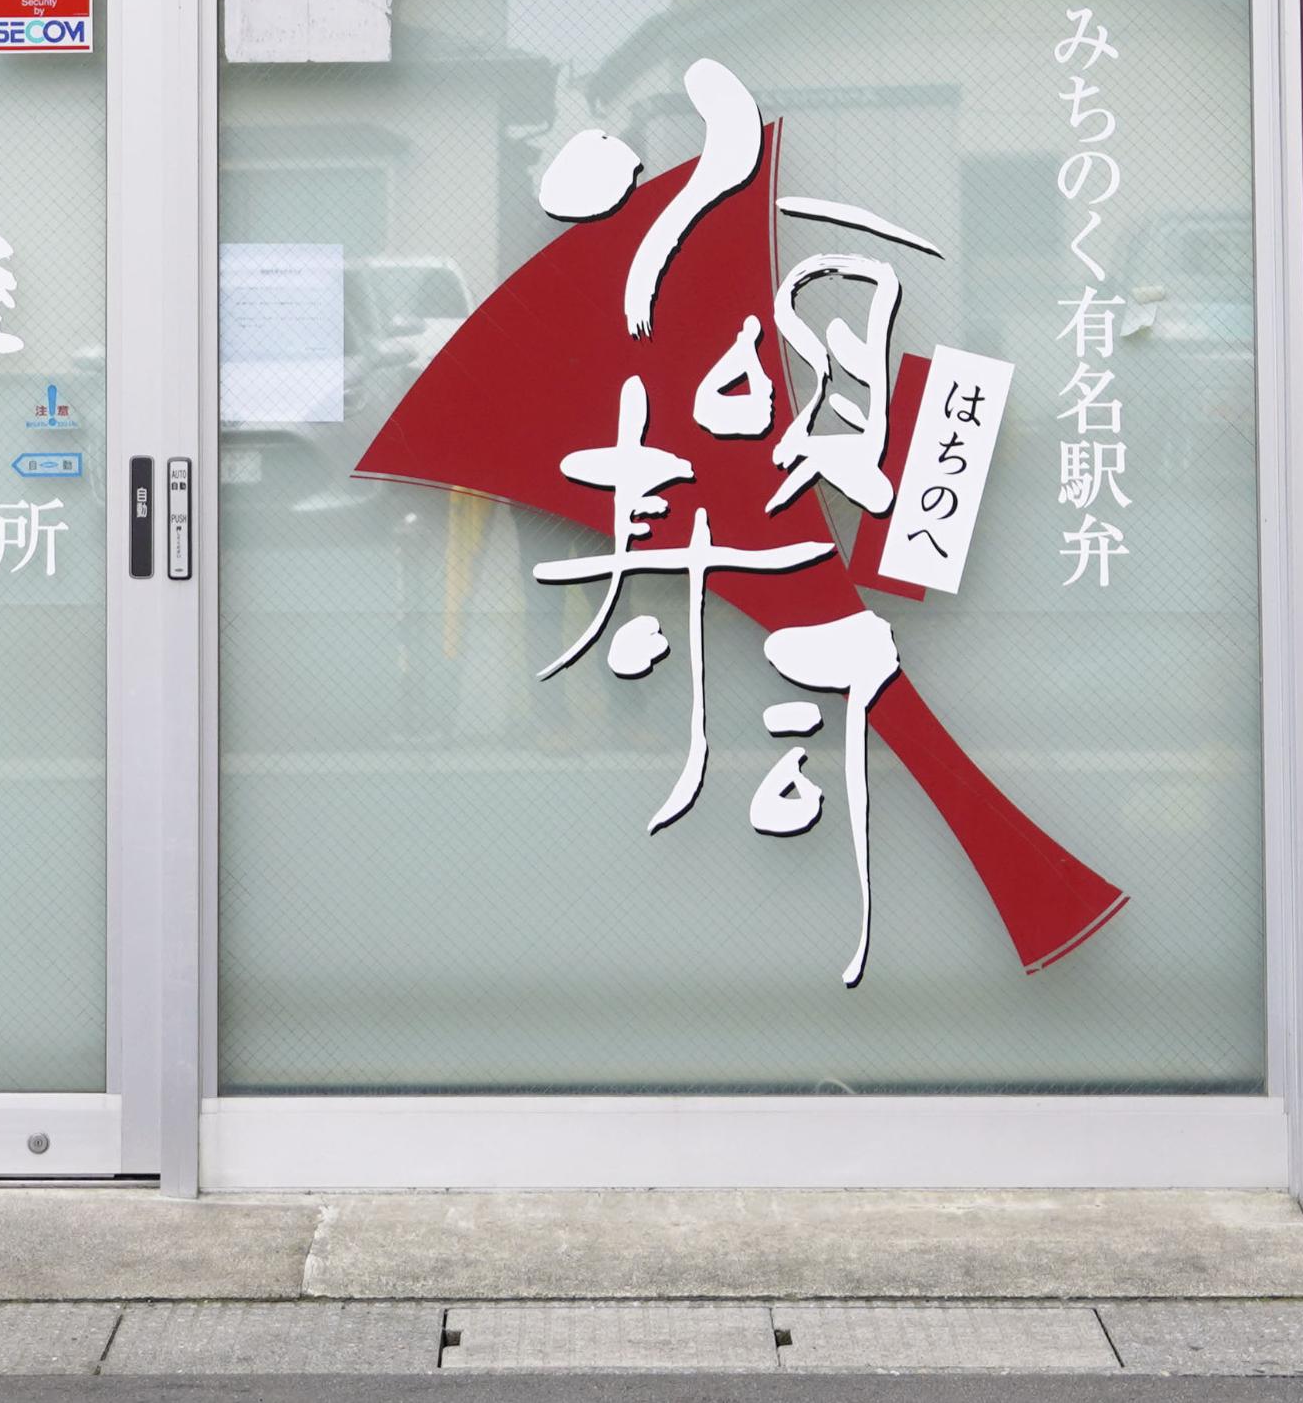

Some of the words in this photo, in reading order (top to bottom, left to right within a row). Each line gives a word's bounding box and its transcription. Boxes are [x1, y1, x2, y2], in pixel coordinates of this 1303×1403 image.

[33, 7, 45, 17] by
[1054, 6, 1133, 588] みちのく有名駅弁
[171, 469, 186, 479] AUTO
[907, 380, 985, 558] はちのへ
[170, 514, 186, 523] PUSH
